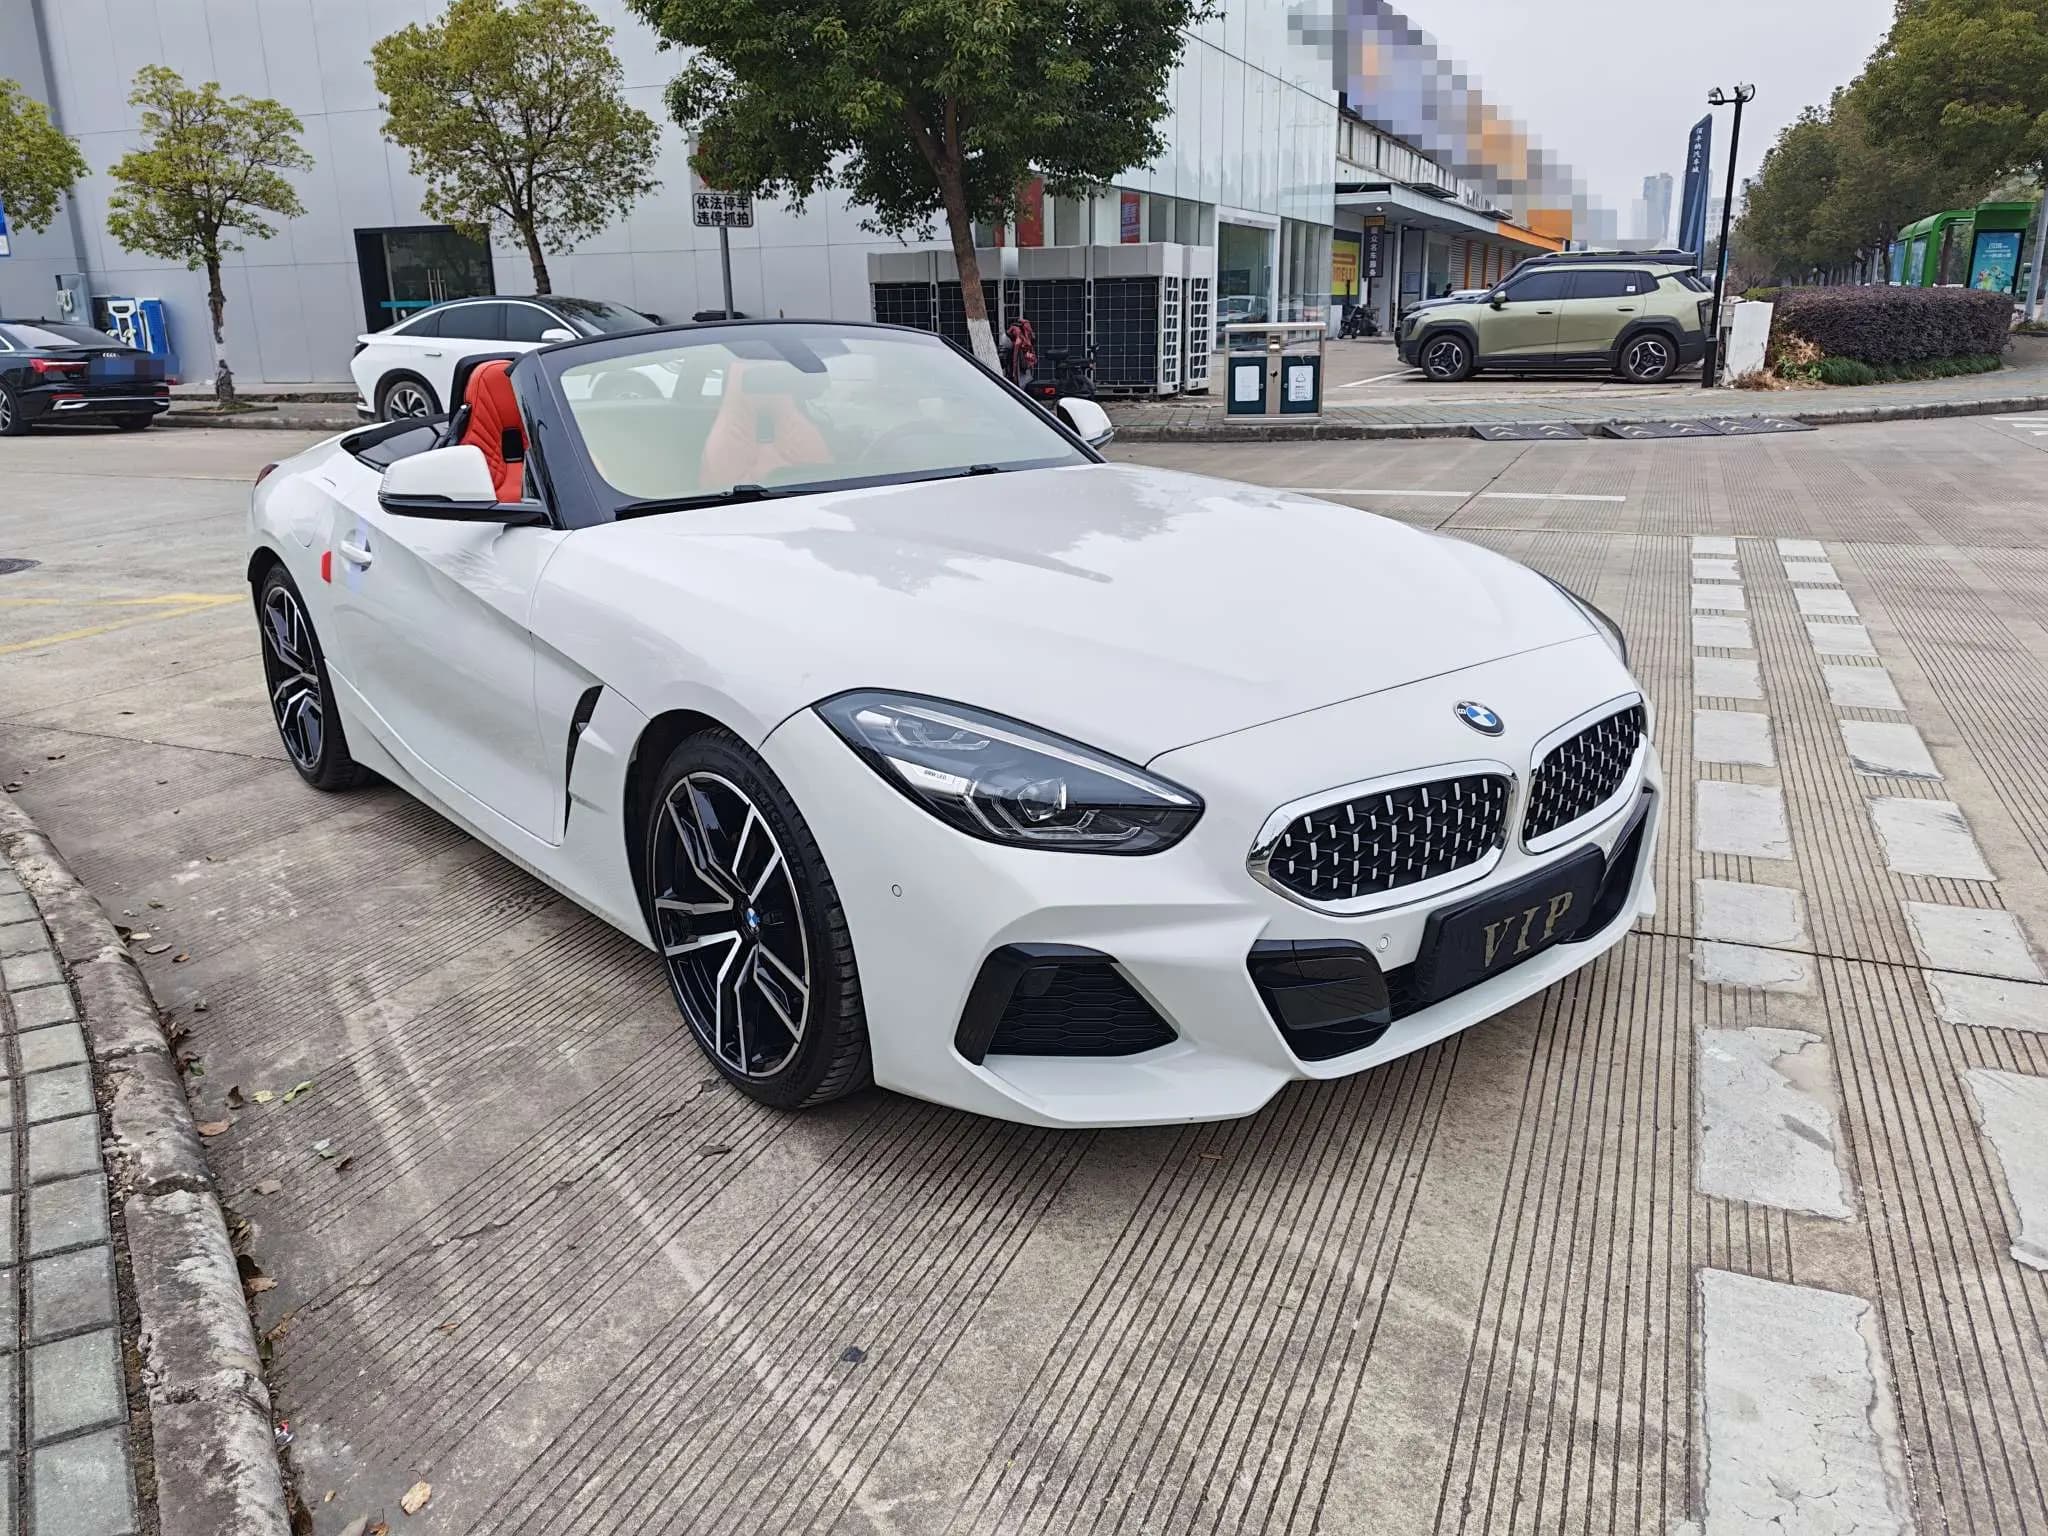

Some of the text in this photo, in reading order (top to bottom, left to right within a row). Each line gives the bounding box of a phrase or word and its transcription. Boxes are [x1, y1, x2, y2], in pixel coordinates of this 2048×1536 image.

[697, 195, 749, 210] 依法停车
[697, 211, 749, 225] 违停抓拍
[1482, 891, 1574, 968] VIP
